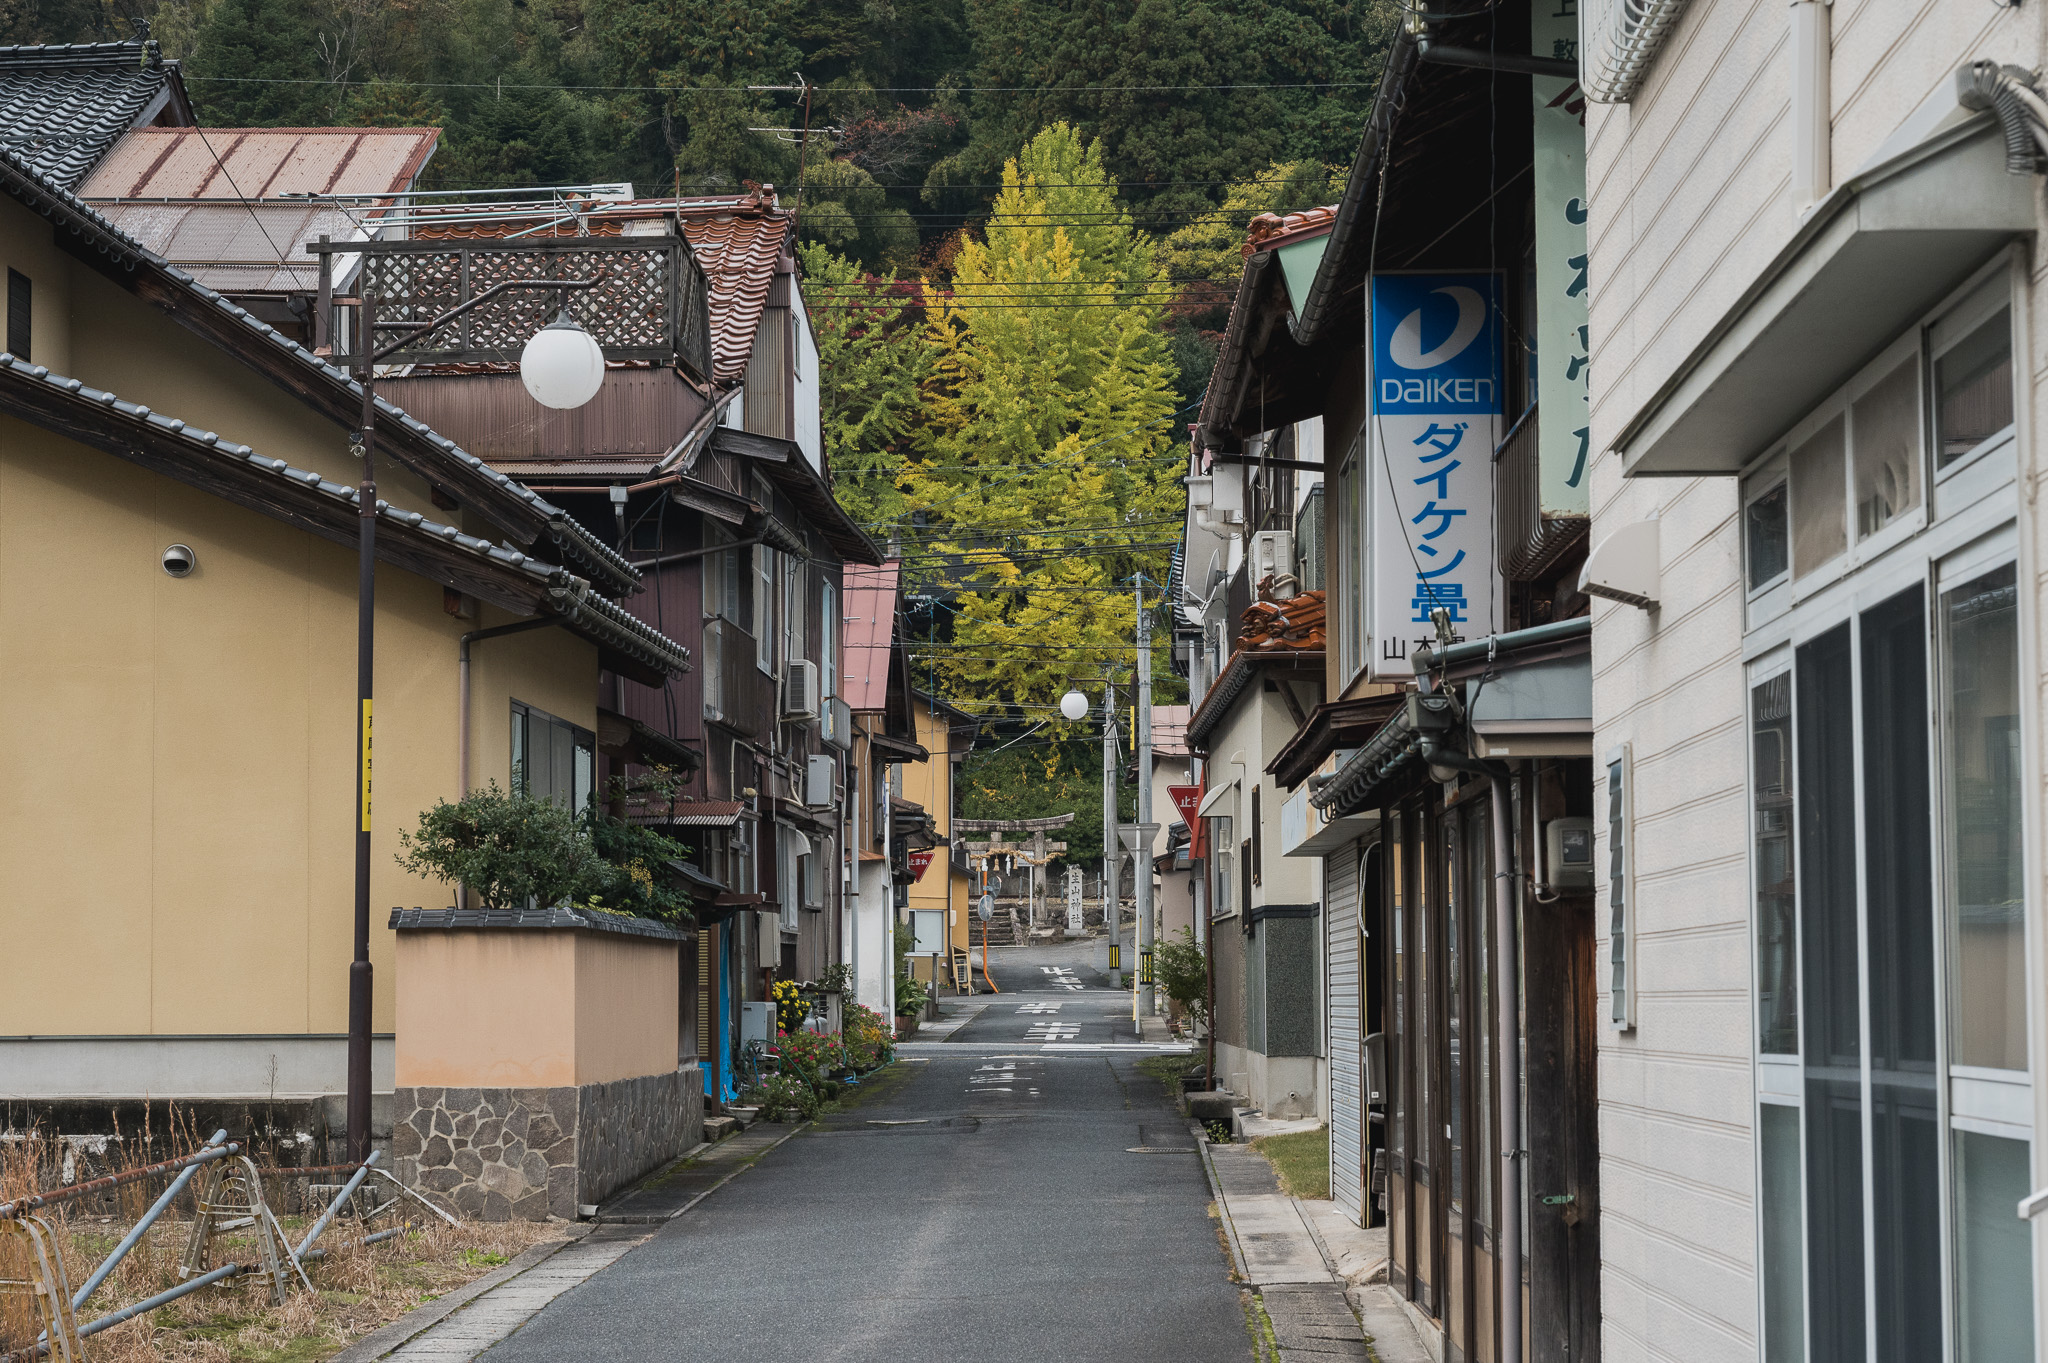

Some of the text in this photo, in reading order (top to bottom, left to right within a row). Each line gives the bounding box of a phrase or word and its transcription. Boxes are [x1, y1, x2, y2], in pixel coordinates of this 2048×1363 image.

[1411, 422, 1469, 622] ダイケン畳
[1070, 872, 1081, 924] 生山神社
